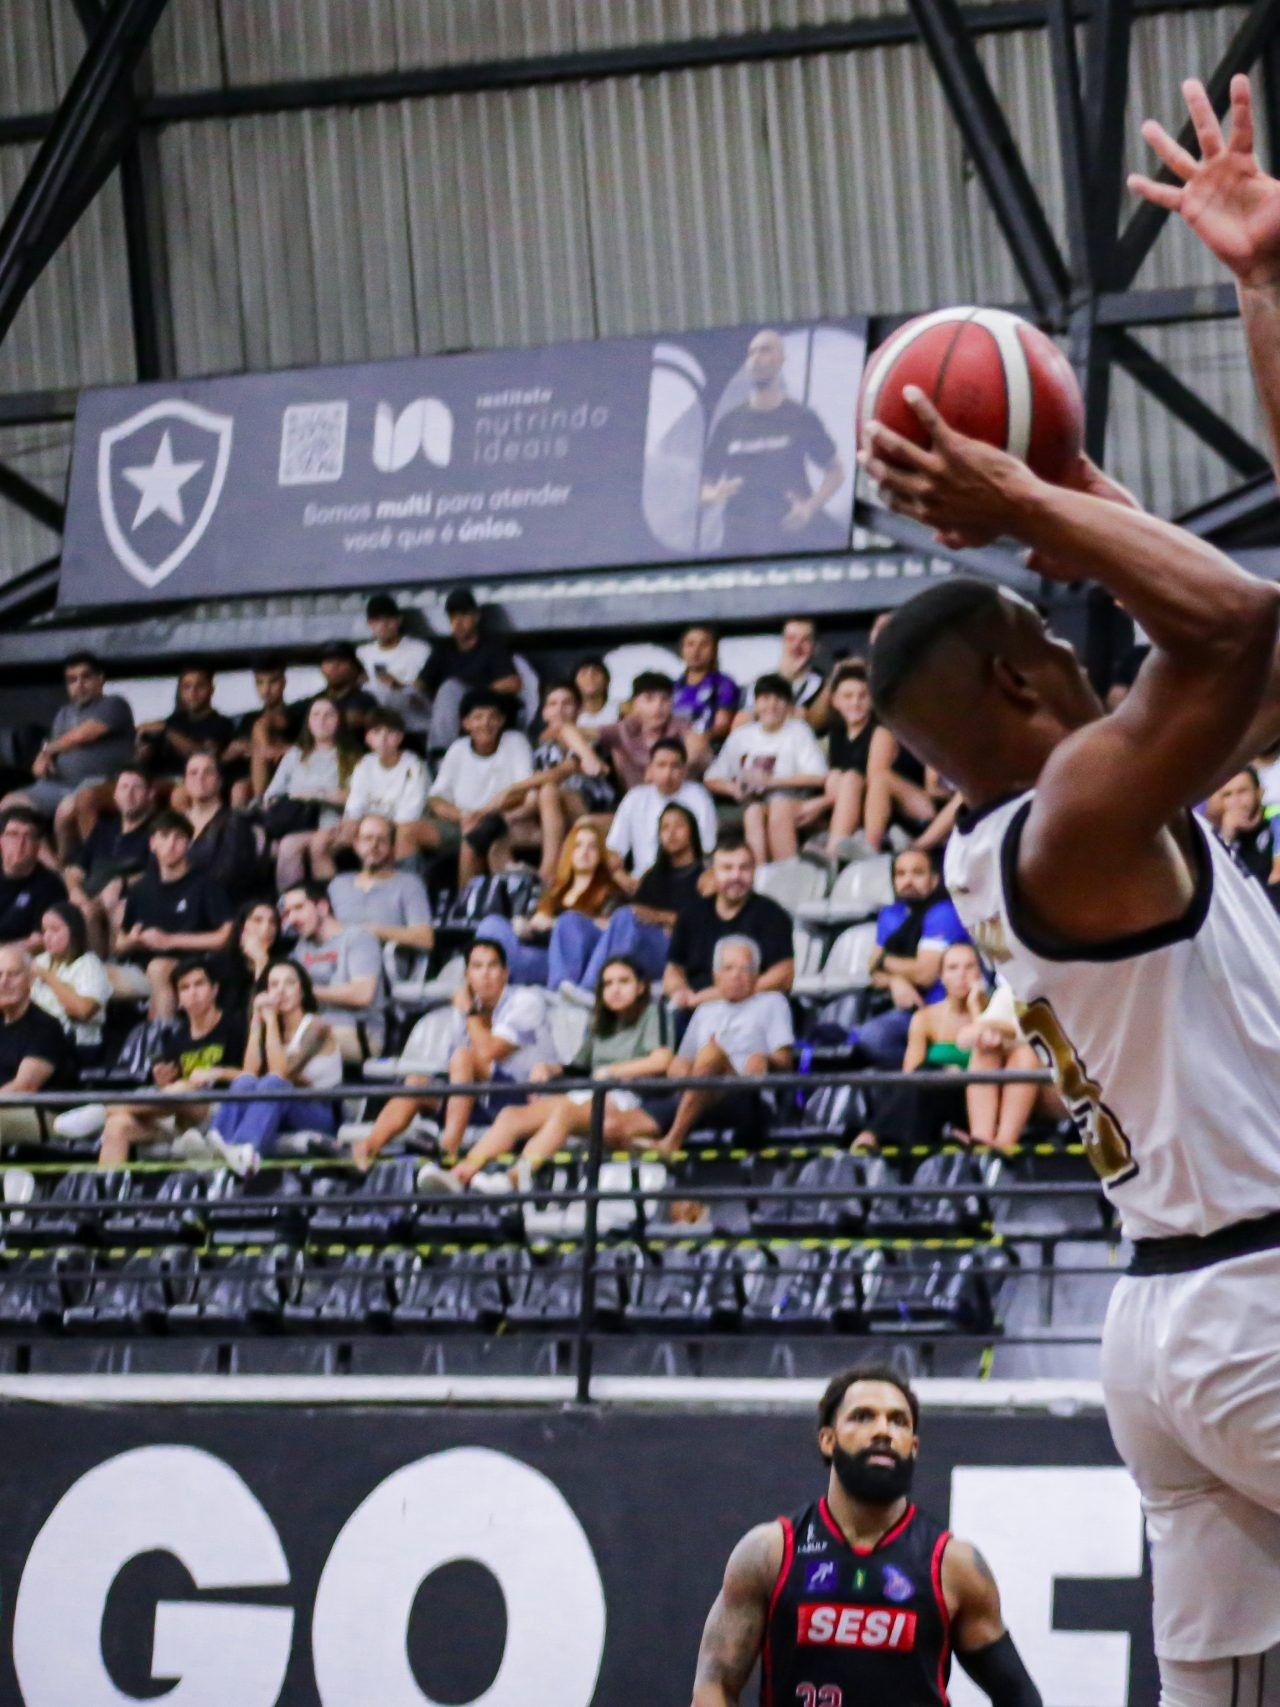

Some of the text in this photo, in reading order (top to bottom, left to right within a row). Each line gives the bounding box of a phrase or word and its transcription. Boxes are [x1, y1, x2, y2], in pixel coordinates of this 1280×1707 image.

[475, 402, 608, 436] nutrindo
[376, 492, 432, 519] multi
[435, 495, 484, 519] para
[488, 482, 572, 512] atender
[396, 528, 436, 552] que
[807, 1606, 906, 1647] SESI
